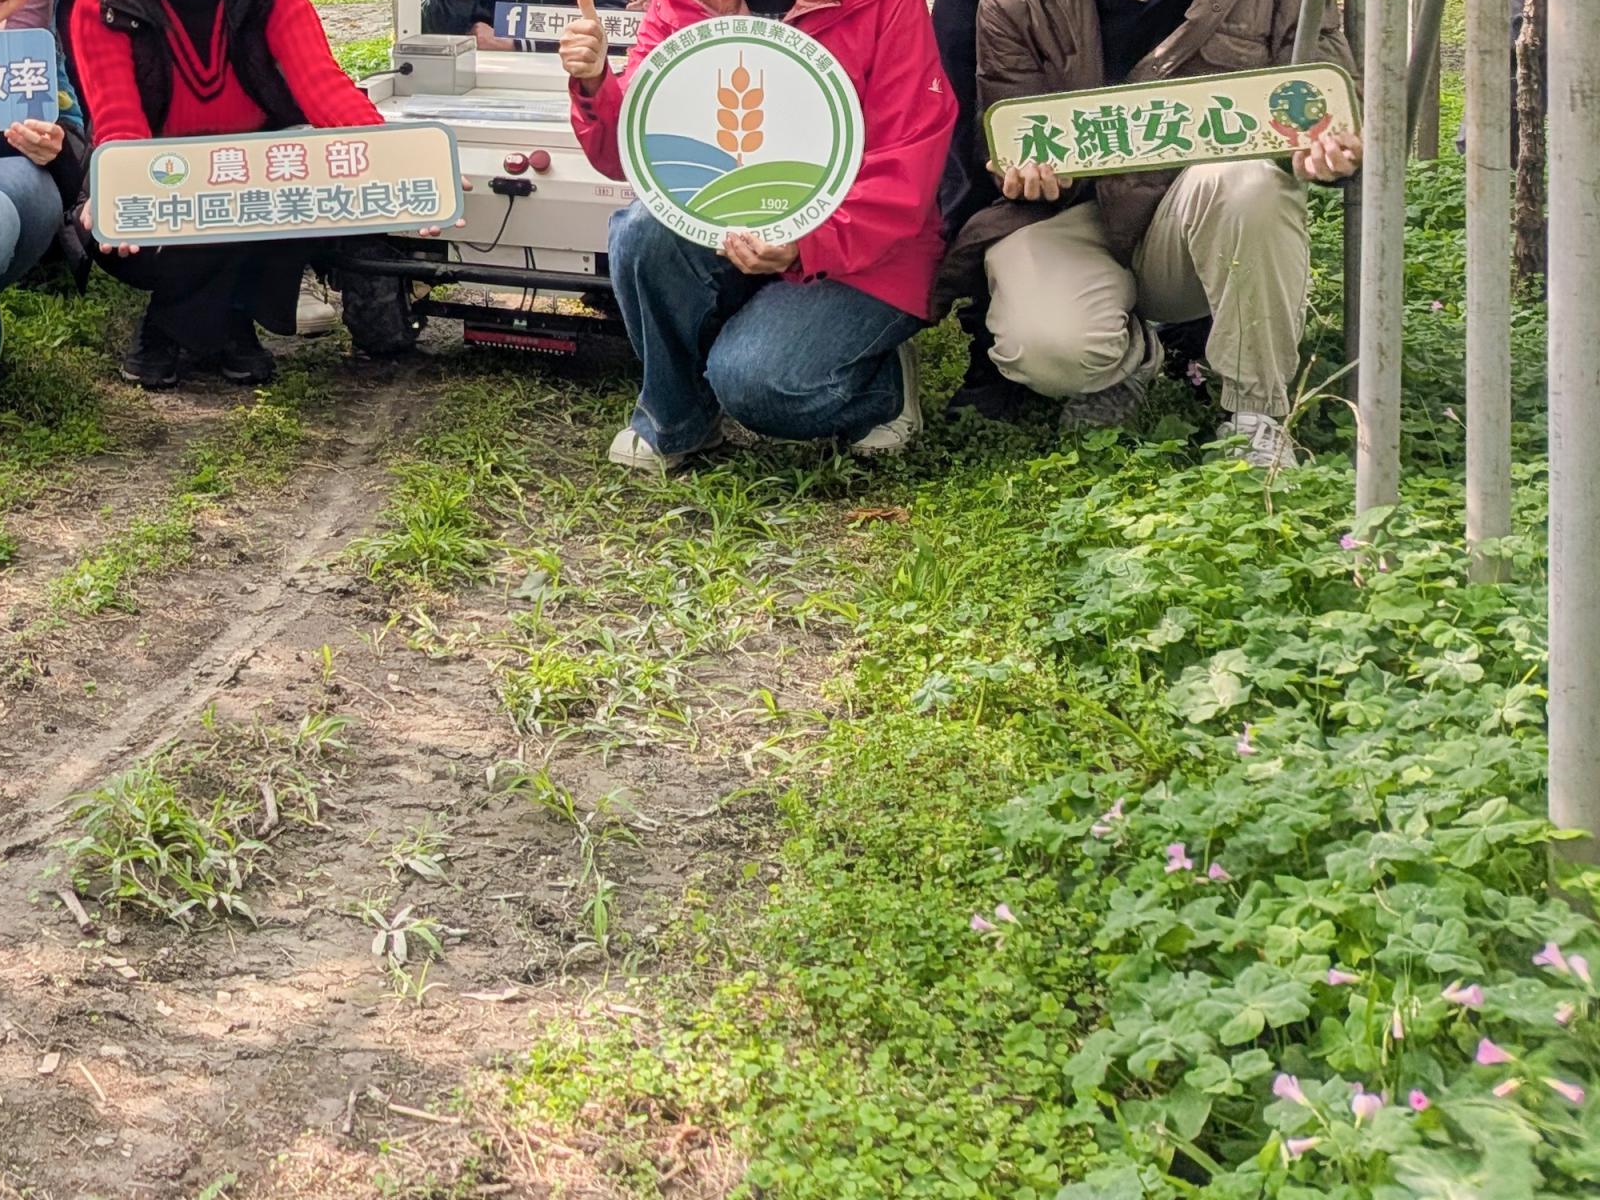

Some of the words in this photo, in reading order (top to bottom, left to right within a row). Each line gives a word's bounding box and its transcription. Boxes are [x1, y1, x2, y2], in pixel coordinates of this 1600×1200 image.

[650, 18, 834, 73] 農業部臺中區農業改良場
[1017, 95, 1258, 166] 永續安心
[207, 141, 369, 186] 農業部
[115, 179, 438, 231] 臺中區農業改良場
[648, 192, 720, 246] Taichung
[794, 198, 832, 231] MOA
[760, 198, 790, 210] 1902
